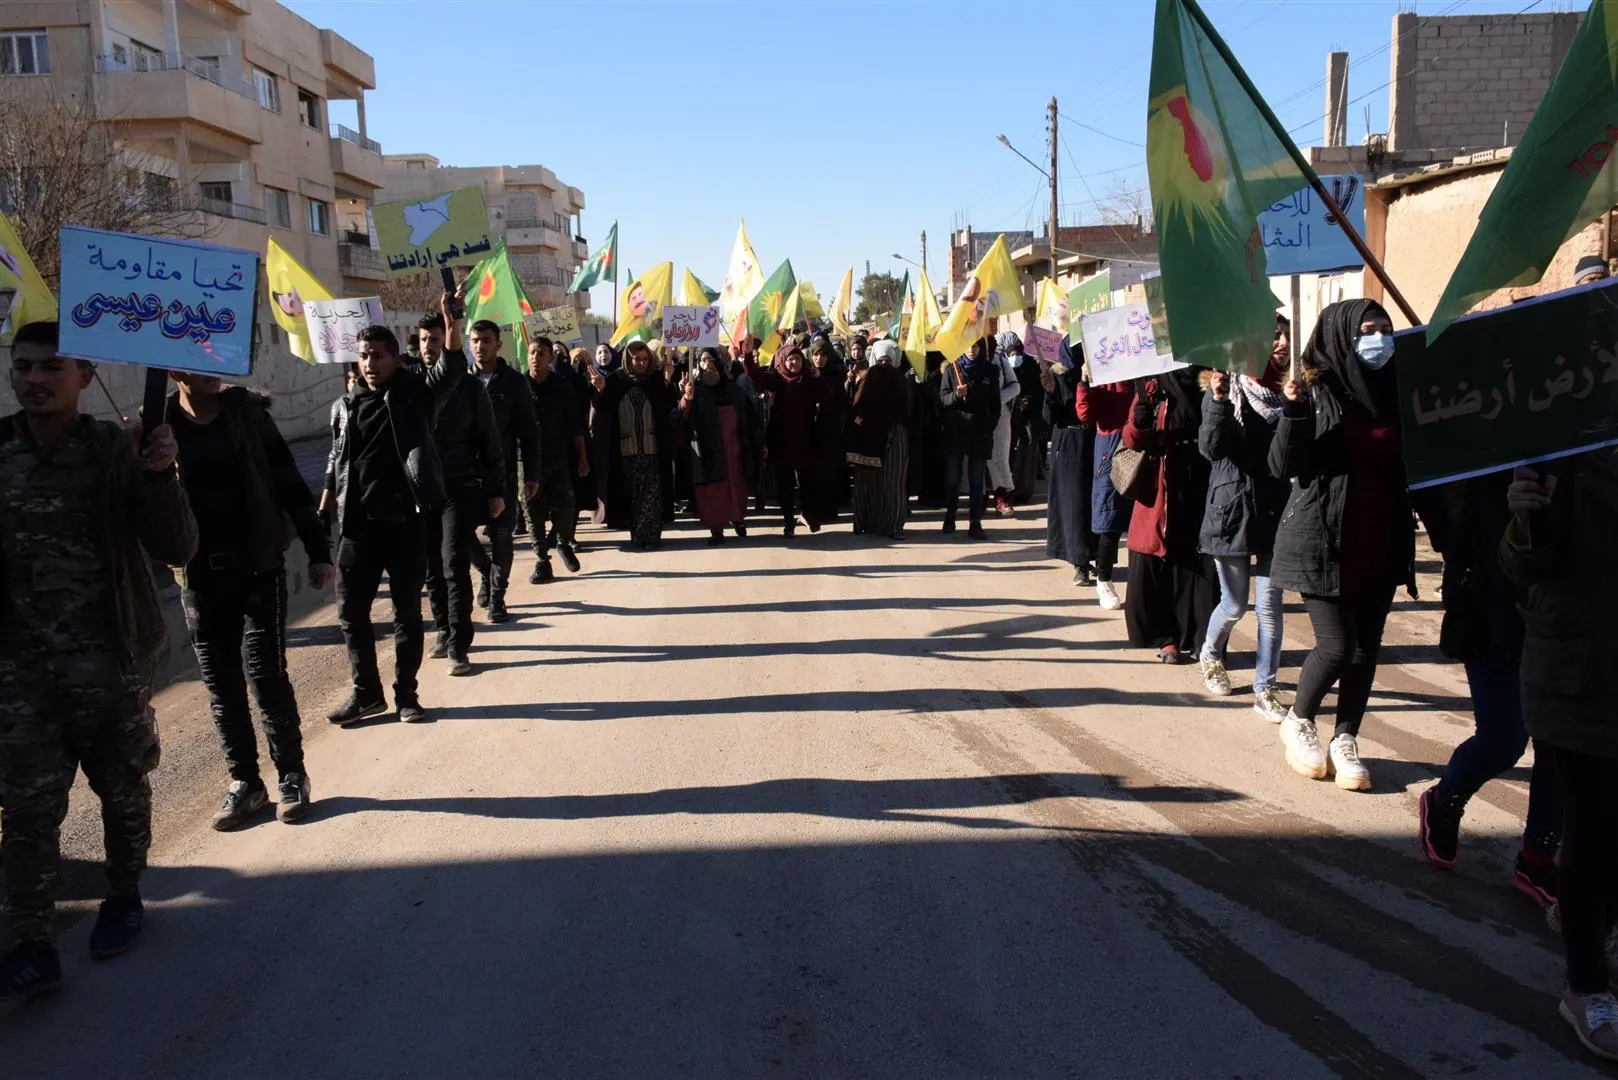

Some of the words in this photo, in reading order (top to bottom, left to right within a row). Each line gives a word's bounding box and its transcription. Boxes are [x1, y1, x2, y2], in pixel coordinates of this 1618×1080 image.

[1262, 186, 1311, 217] للاح
[463, 234, 492, 255] قسد
[1262, 223, 1311, 249] العثما
[87, 243, 182, 281] مقاومة
[387, 248, 434, 271] إرادتنا
[436, 244, 460, 268] هي
[193, 257, 245, 299] تحيا
[72, 292, 163, 332] عيسى
[160, 299, 237, 344] عين
[309, 301, 372, 325] الحرية
[1412, 358, 1516, 425] أرضنا
